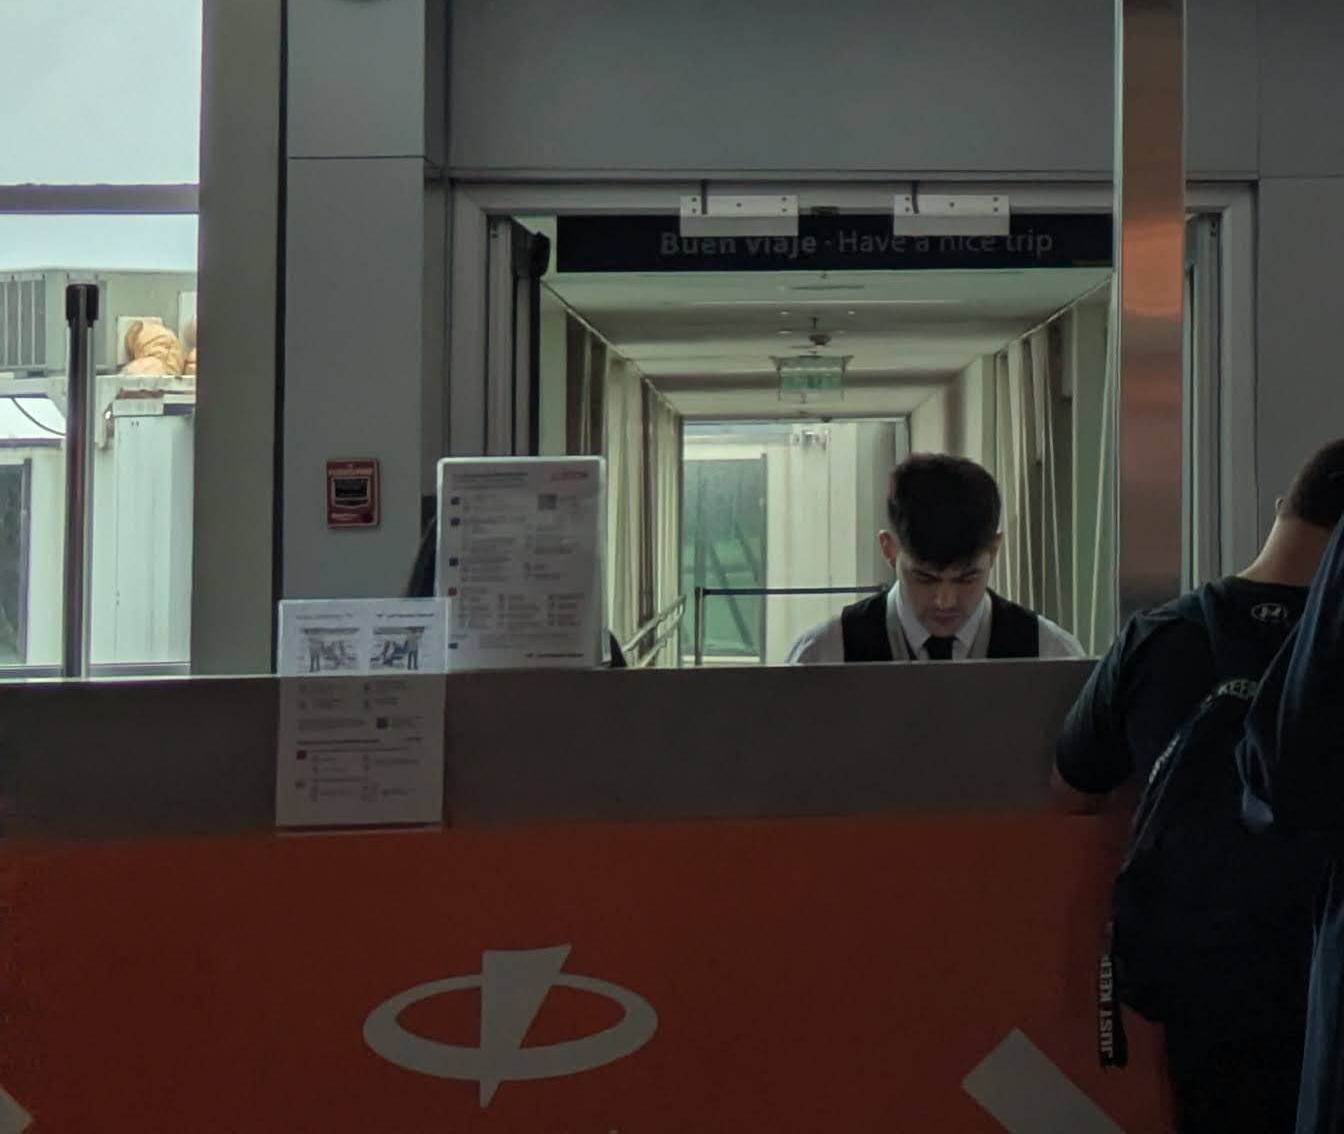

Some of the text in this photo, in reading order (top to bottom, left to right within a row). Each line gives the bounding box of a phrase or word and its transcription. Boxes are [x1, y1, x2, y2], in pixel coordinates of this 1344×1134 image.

[660, 230, 1054, 258] Buen viaje Have a nice trip
[1099, 1009, 1114, 1059] JUST
